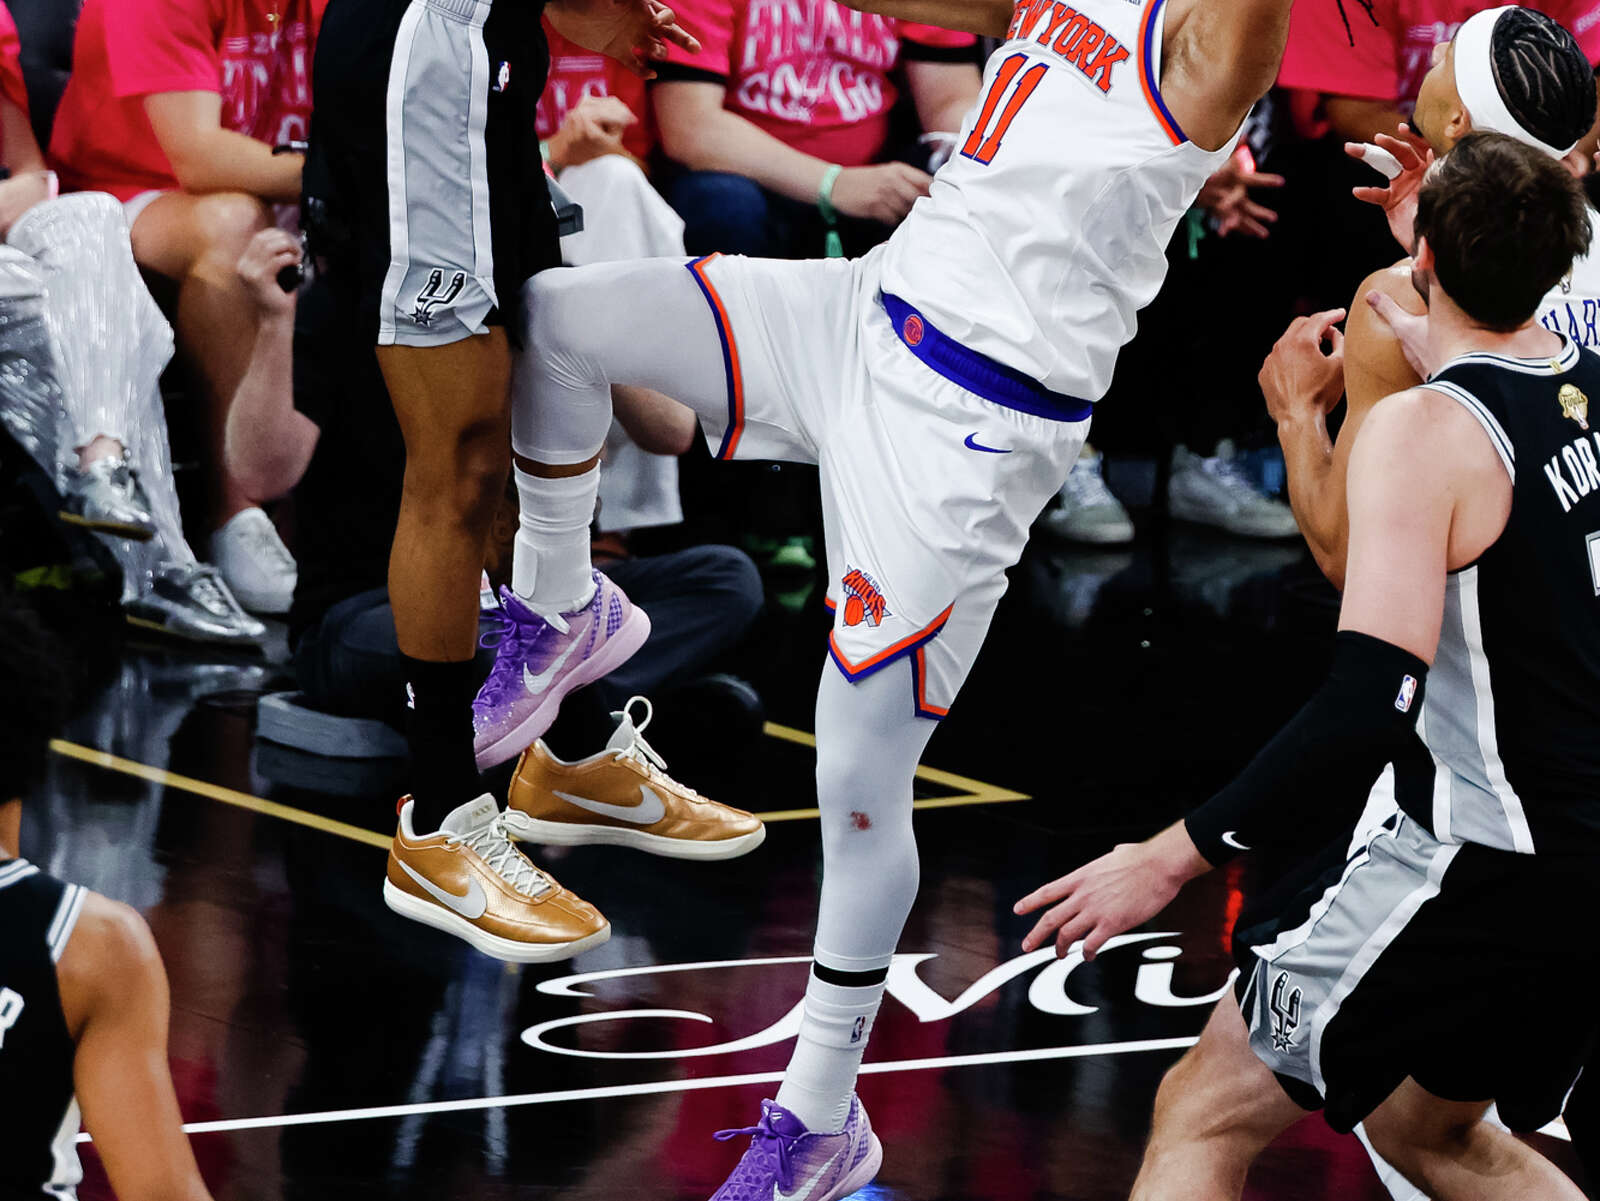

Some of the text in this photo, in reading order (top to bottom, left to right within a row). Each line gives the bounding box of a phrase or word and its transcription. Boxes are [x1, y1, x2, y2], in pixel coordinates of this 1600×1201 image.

[1036, 1, 1130, 95] YORK
[959, 52, 1051, 166] 11
[1543, 430, 1600, 513] KOR
[842, 569, 887, 627] KNICKS
